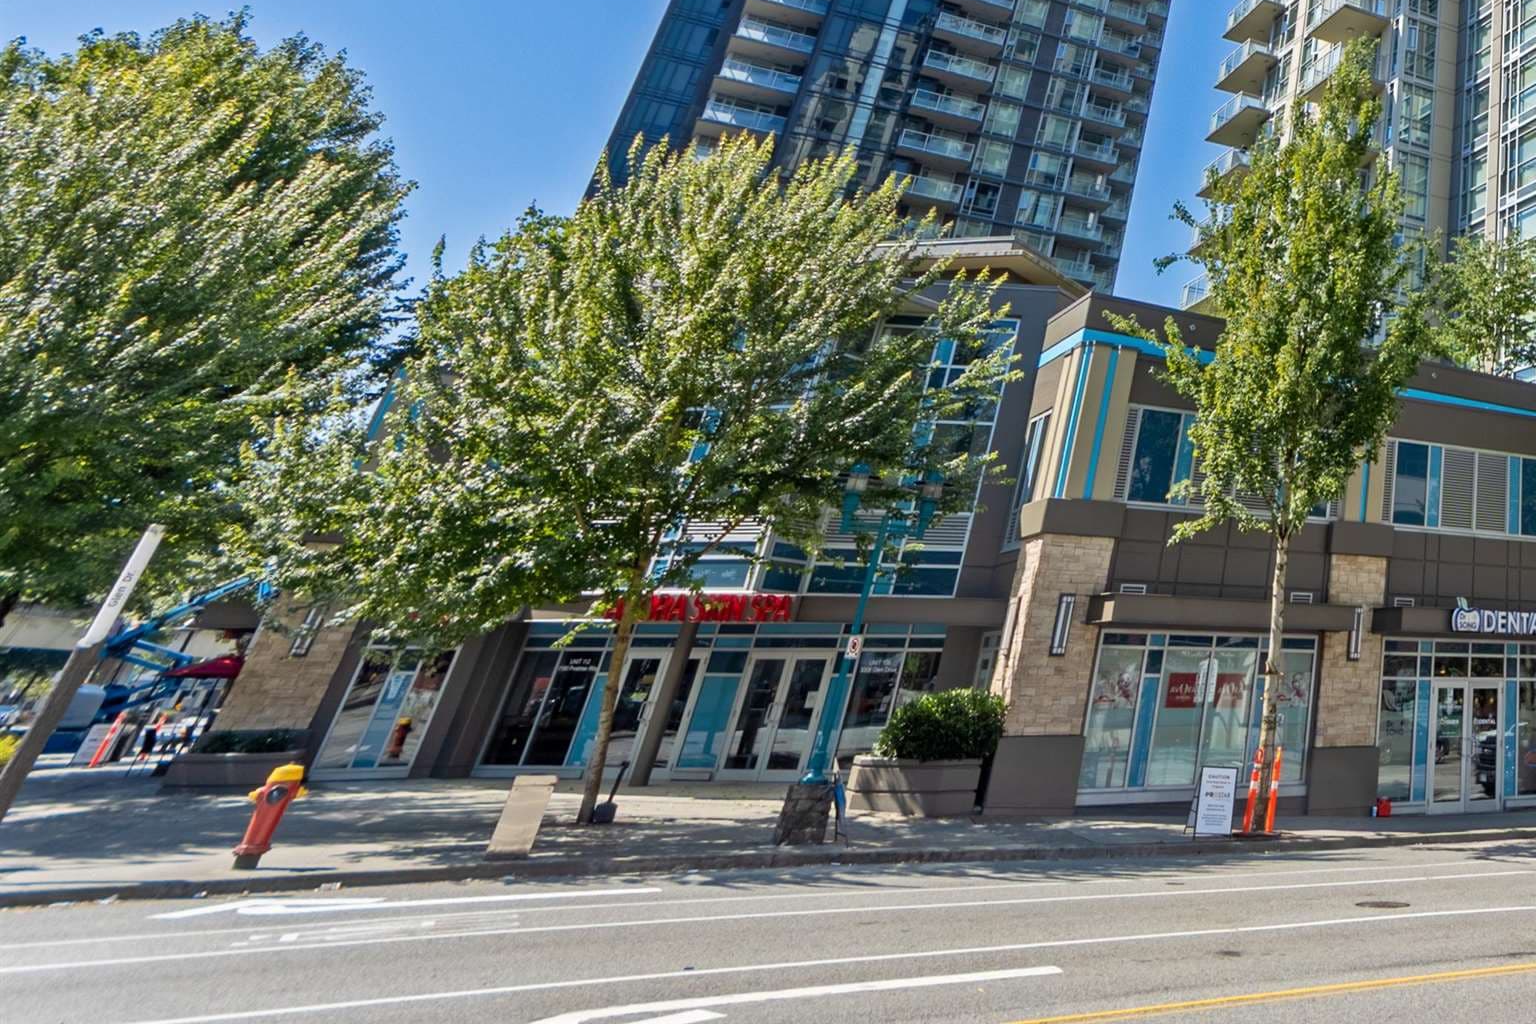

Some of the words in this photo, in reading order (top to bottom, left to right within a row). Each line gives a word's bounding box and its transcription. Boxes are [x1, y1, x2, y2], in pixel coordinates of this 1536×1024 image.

[108, 587, 127, 608] Glen
[122, 571, 135, 582] Dr
[603, 594, 687, 622] ARA
[747, 594, 792, 622] SPA
